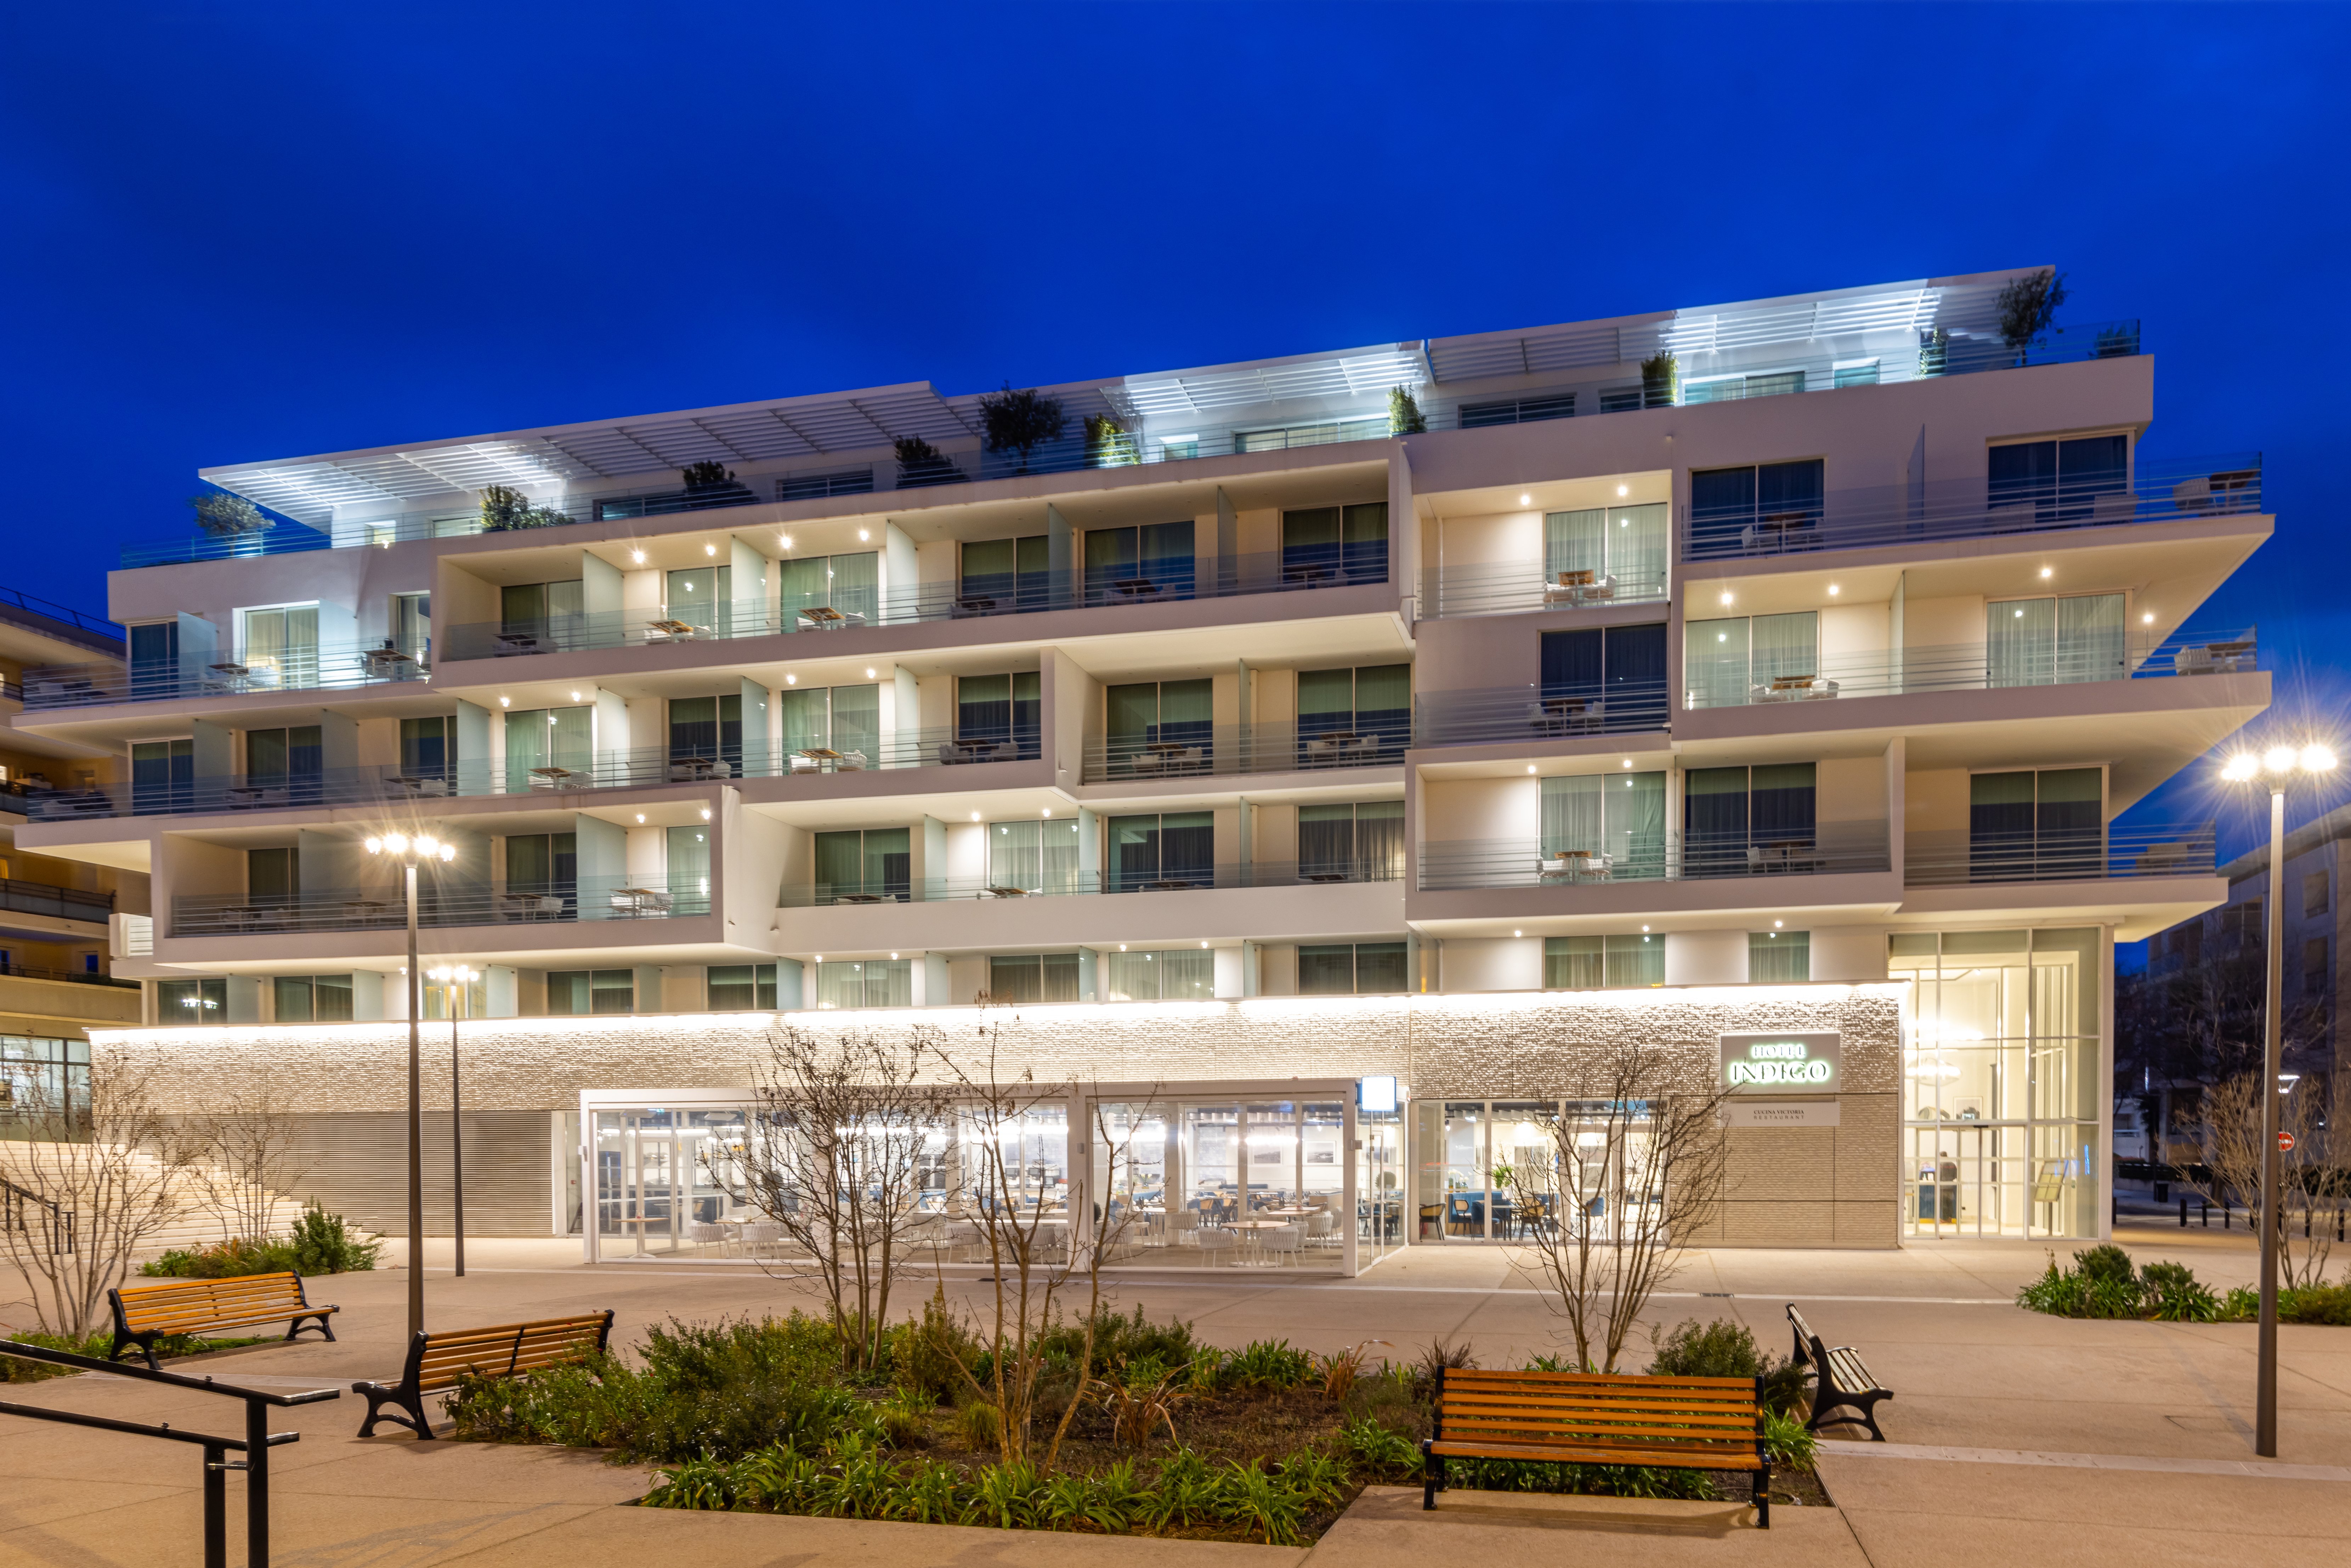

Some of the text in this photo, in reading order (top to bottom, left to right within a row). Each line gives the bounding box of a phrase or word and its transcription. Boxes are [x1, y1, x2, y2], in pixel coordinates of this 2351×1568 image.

[1755, 1046, 1806, 1056] HOTEL
[1734, 1063, 1826, 1080] INDIGO
[907, 1087, 985, 1096] RESAURANT
